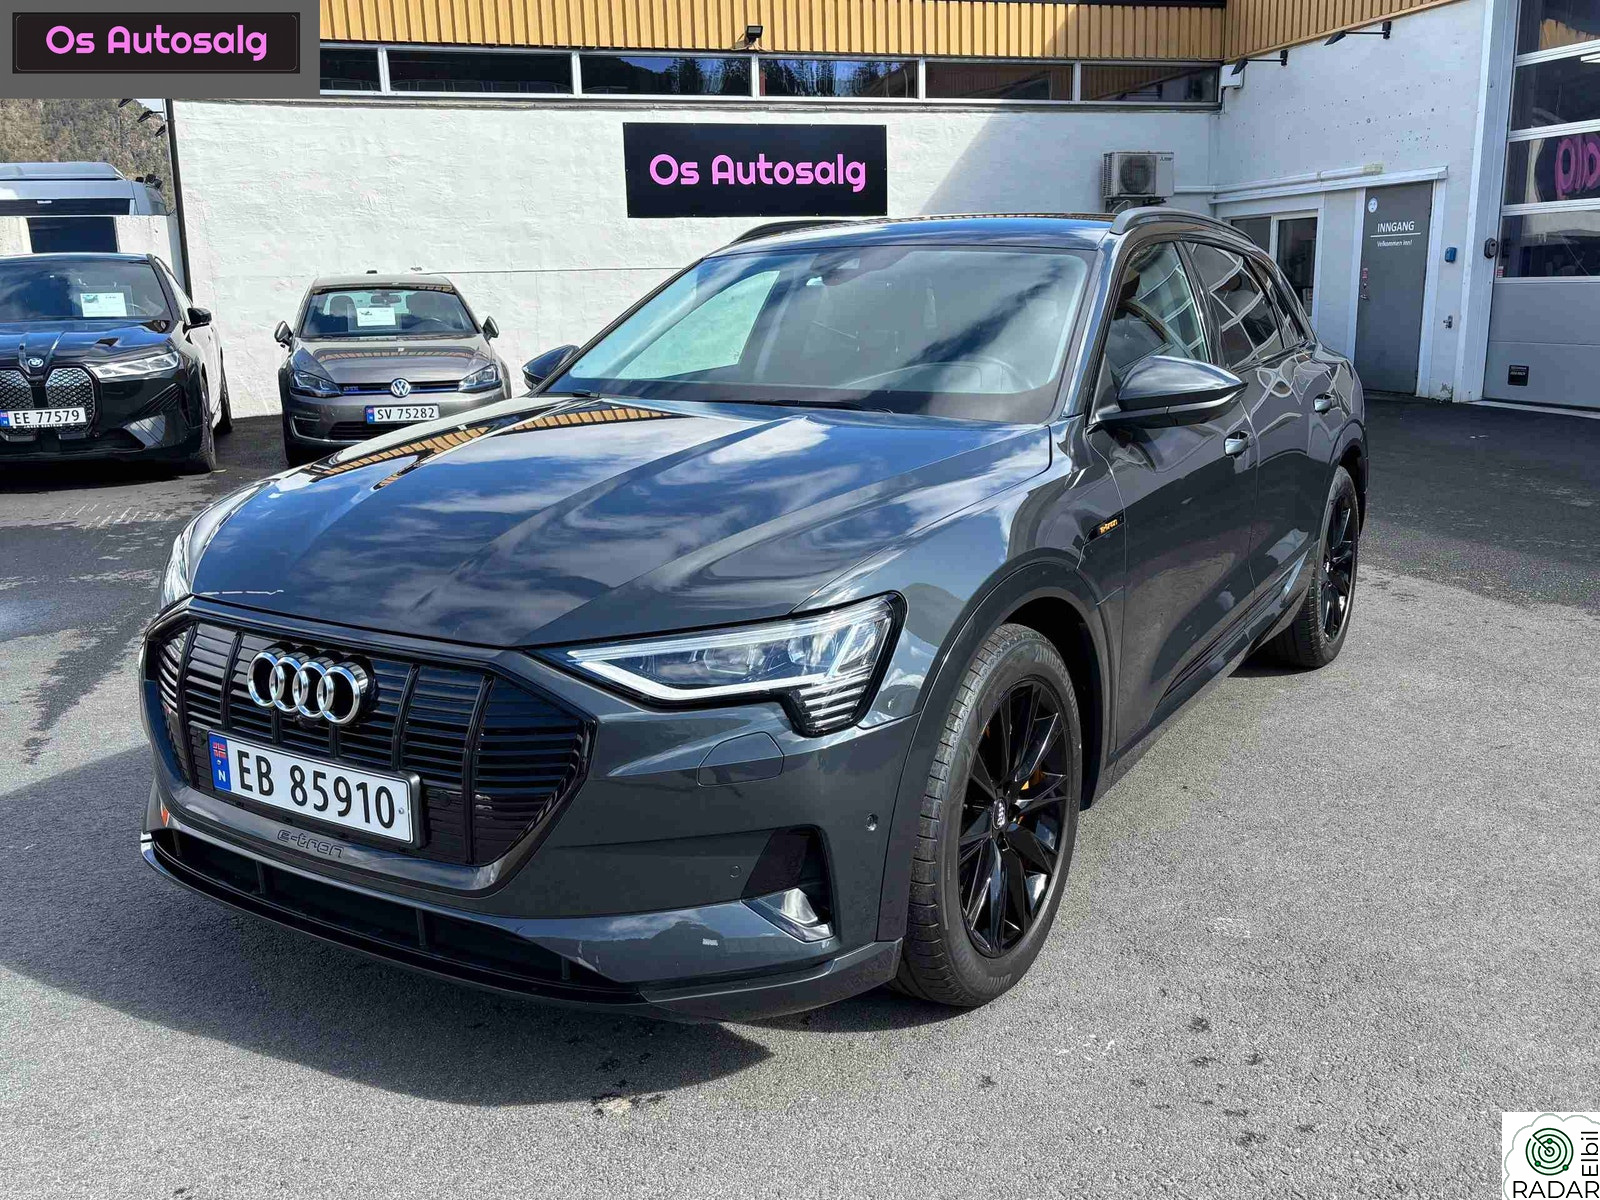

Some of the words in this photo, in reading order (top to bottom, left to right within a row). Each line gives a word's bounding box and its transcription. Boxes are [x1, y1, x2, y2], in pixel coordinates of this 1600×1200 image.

[649, 153, 700, 186] Os
[711, 153, 867, 193] Autosalg
[1377, 220, 1415, 233] INNGANG
[13, 412, 31, 425] EE
[35, 409, 80, 423] 77579
[377, 408, 392, 420] SV
[397, 407, 435, 419] 75282
[218, 769, 227, 783] N
[237, 750, 274, 796] EB
[289, 764, 395, 829] 85910
[277, 829, 344, 858] e-tron
